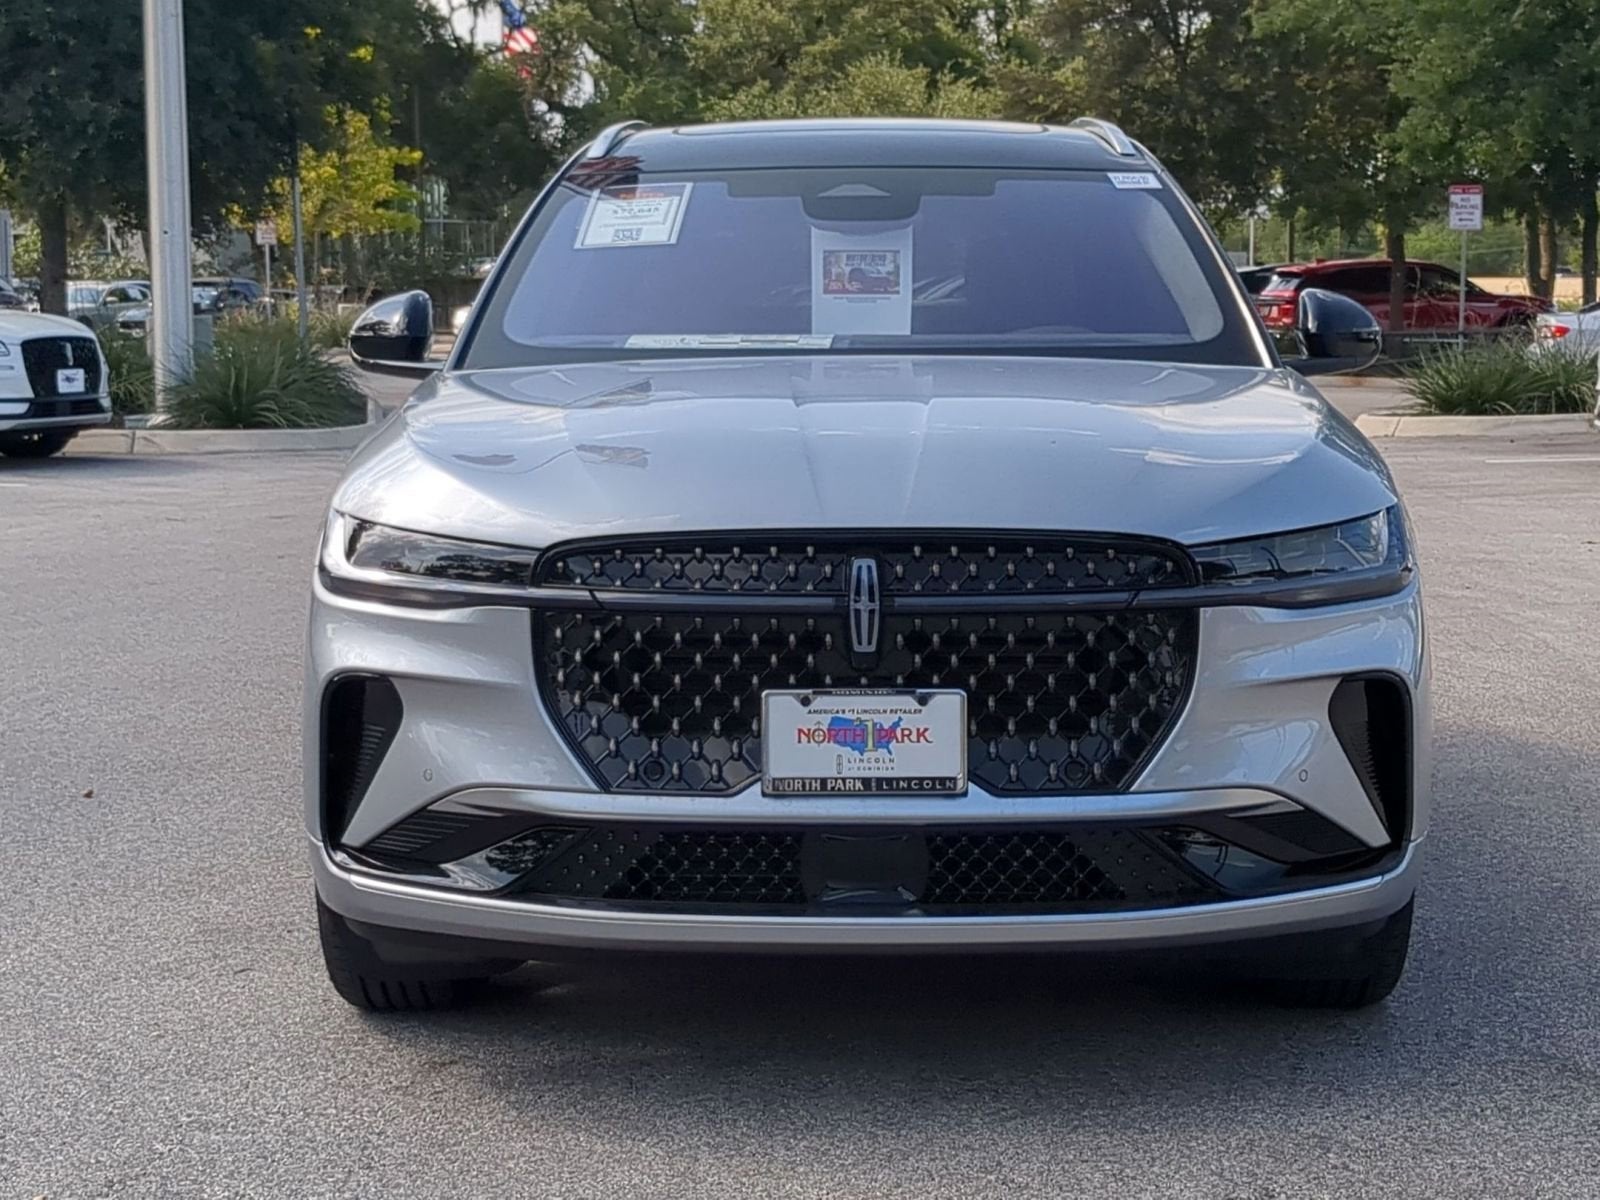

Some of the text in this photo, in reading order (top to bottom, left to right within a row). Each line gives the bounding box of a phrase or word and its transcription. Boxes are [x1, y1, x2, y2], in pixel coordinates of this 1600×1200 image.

[797, 728, 933, 744] NORTH PARK
[774, 779, 955, 791] NORTH PARK LINCOLN
